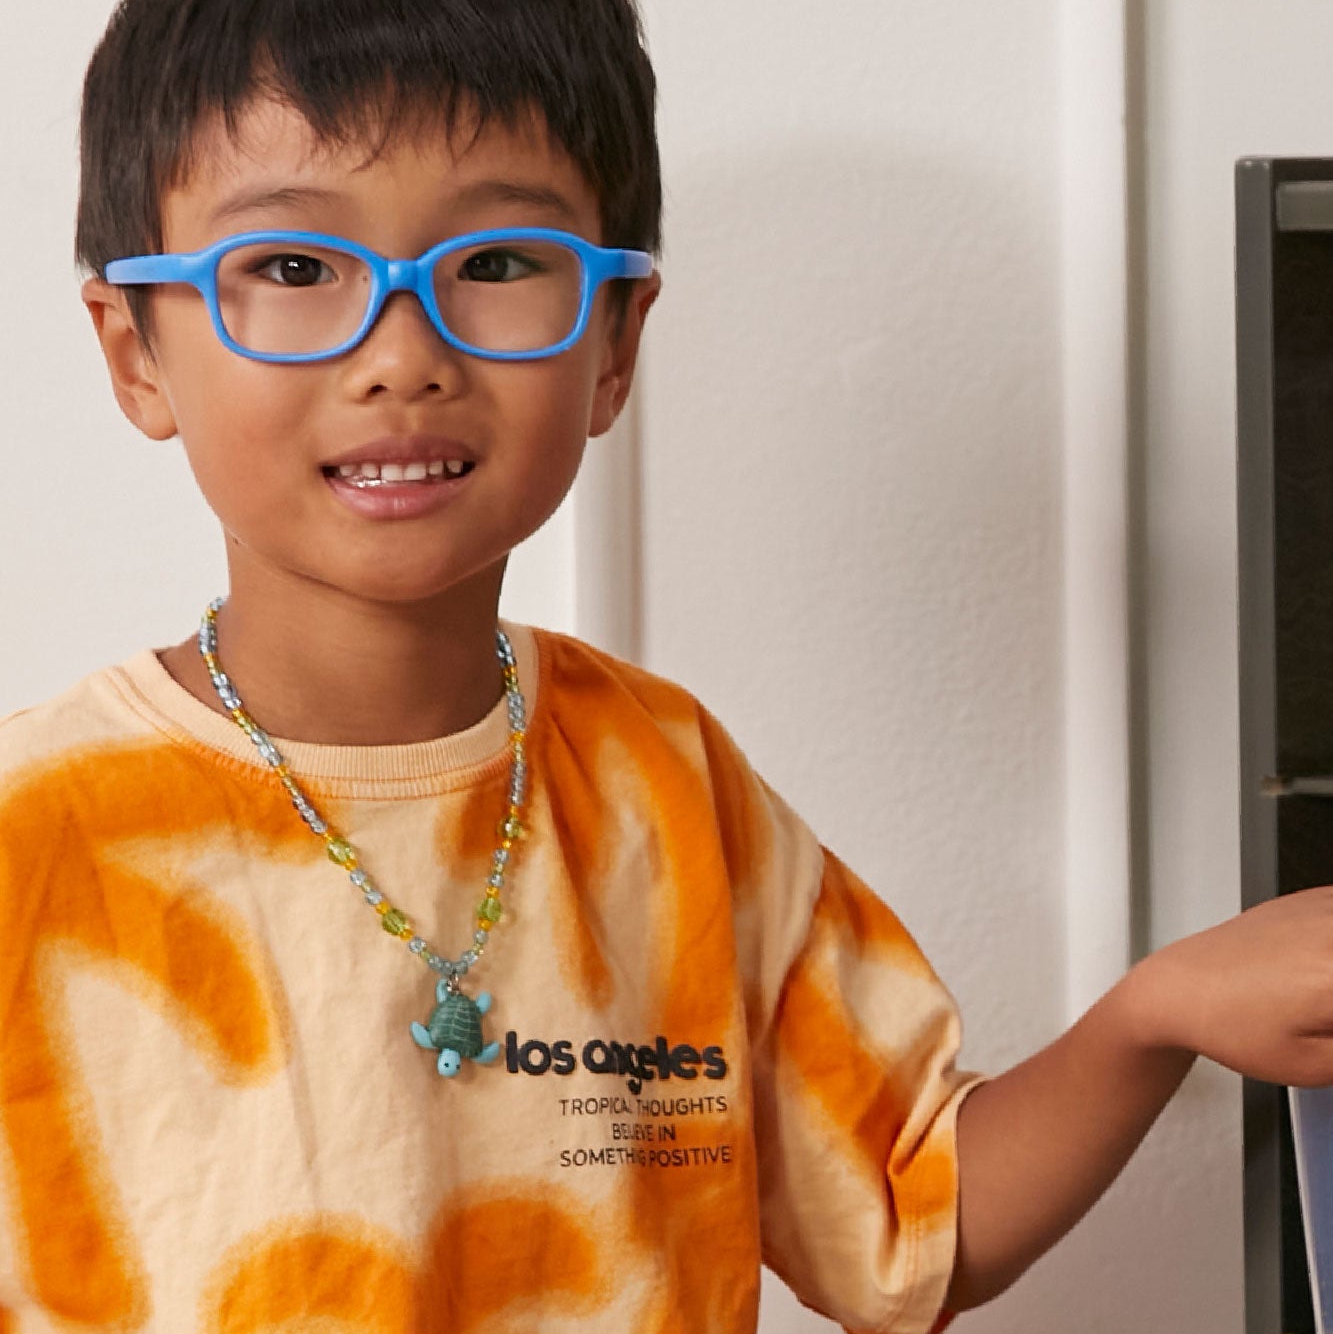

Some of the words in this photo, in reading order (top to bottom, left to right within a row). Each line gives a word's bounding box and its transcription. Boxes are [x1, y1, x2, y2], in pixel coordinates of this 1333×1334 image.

[506, 1031, 576, 1075] los
[582, 1036, 728, 1095] angeles
[558, 1097, 632, 1116] TROPICAL
[636, 1096, 728, 1117] THOUGHTS
[658, 1124, 676, 1142] IN
[649, 1145, 734, 1167] POSITIVE
